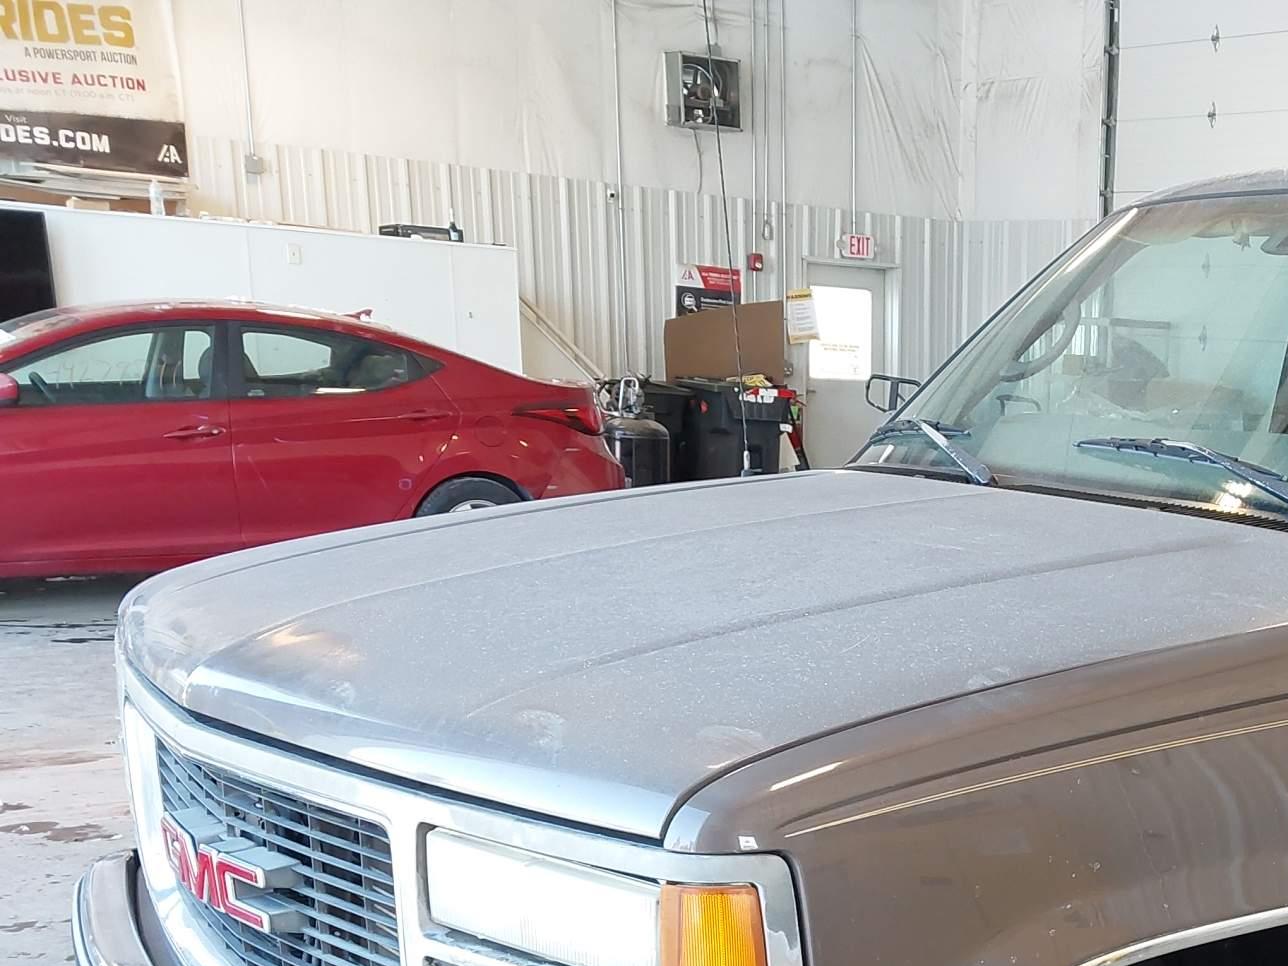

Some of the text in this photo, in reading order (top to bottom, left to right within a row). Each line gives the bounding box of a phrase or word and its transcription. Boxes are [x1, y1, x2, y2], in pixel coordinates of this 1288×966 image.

[24, 46, 138, 65] A POWERSPORT AUCTION
[71, 73, 146, 91] AUCTION
[4, 114, 28, 123] Visit
[850, 235, 871, 256] EXIT
[160, 811, 272, 934] GMC
